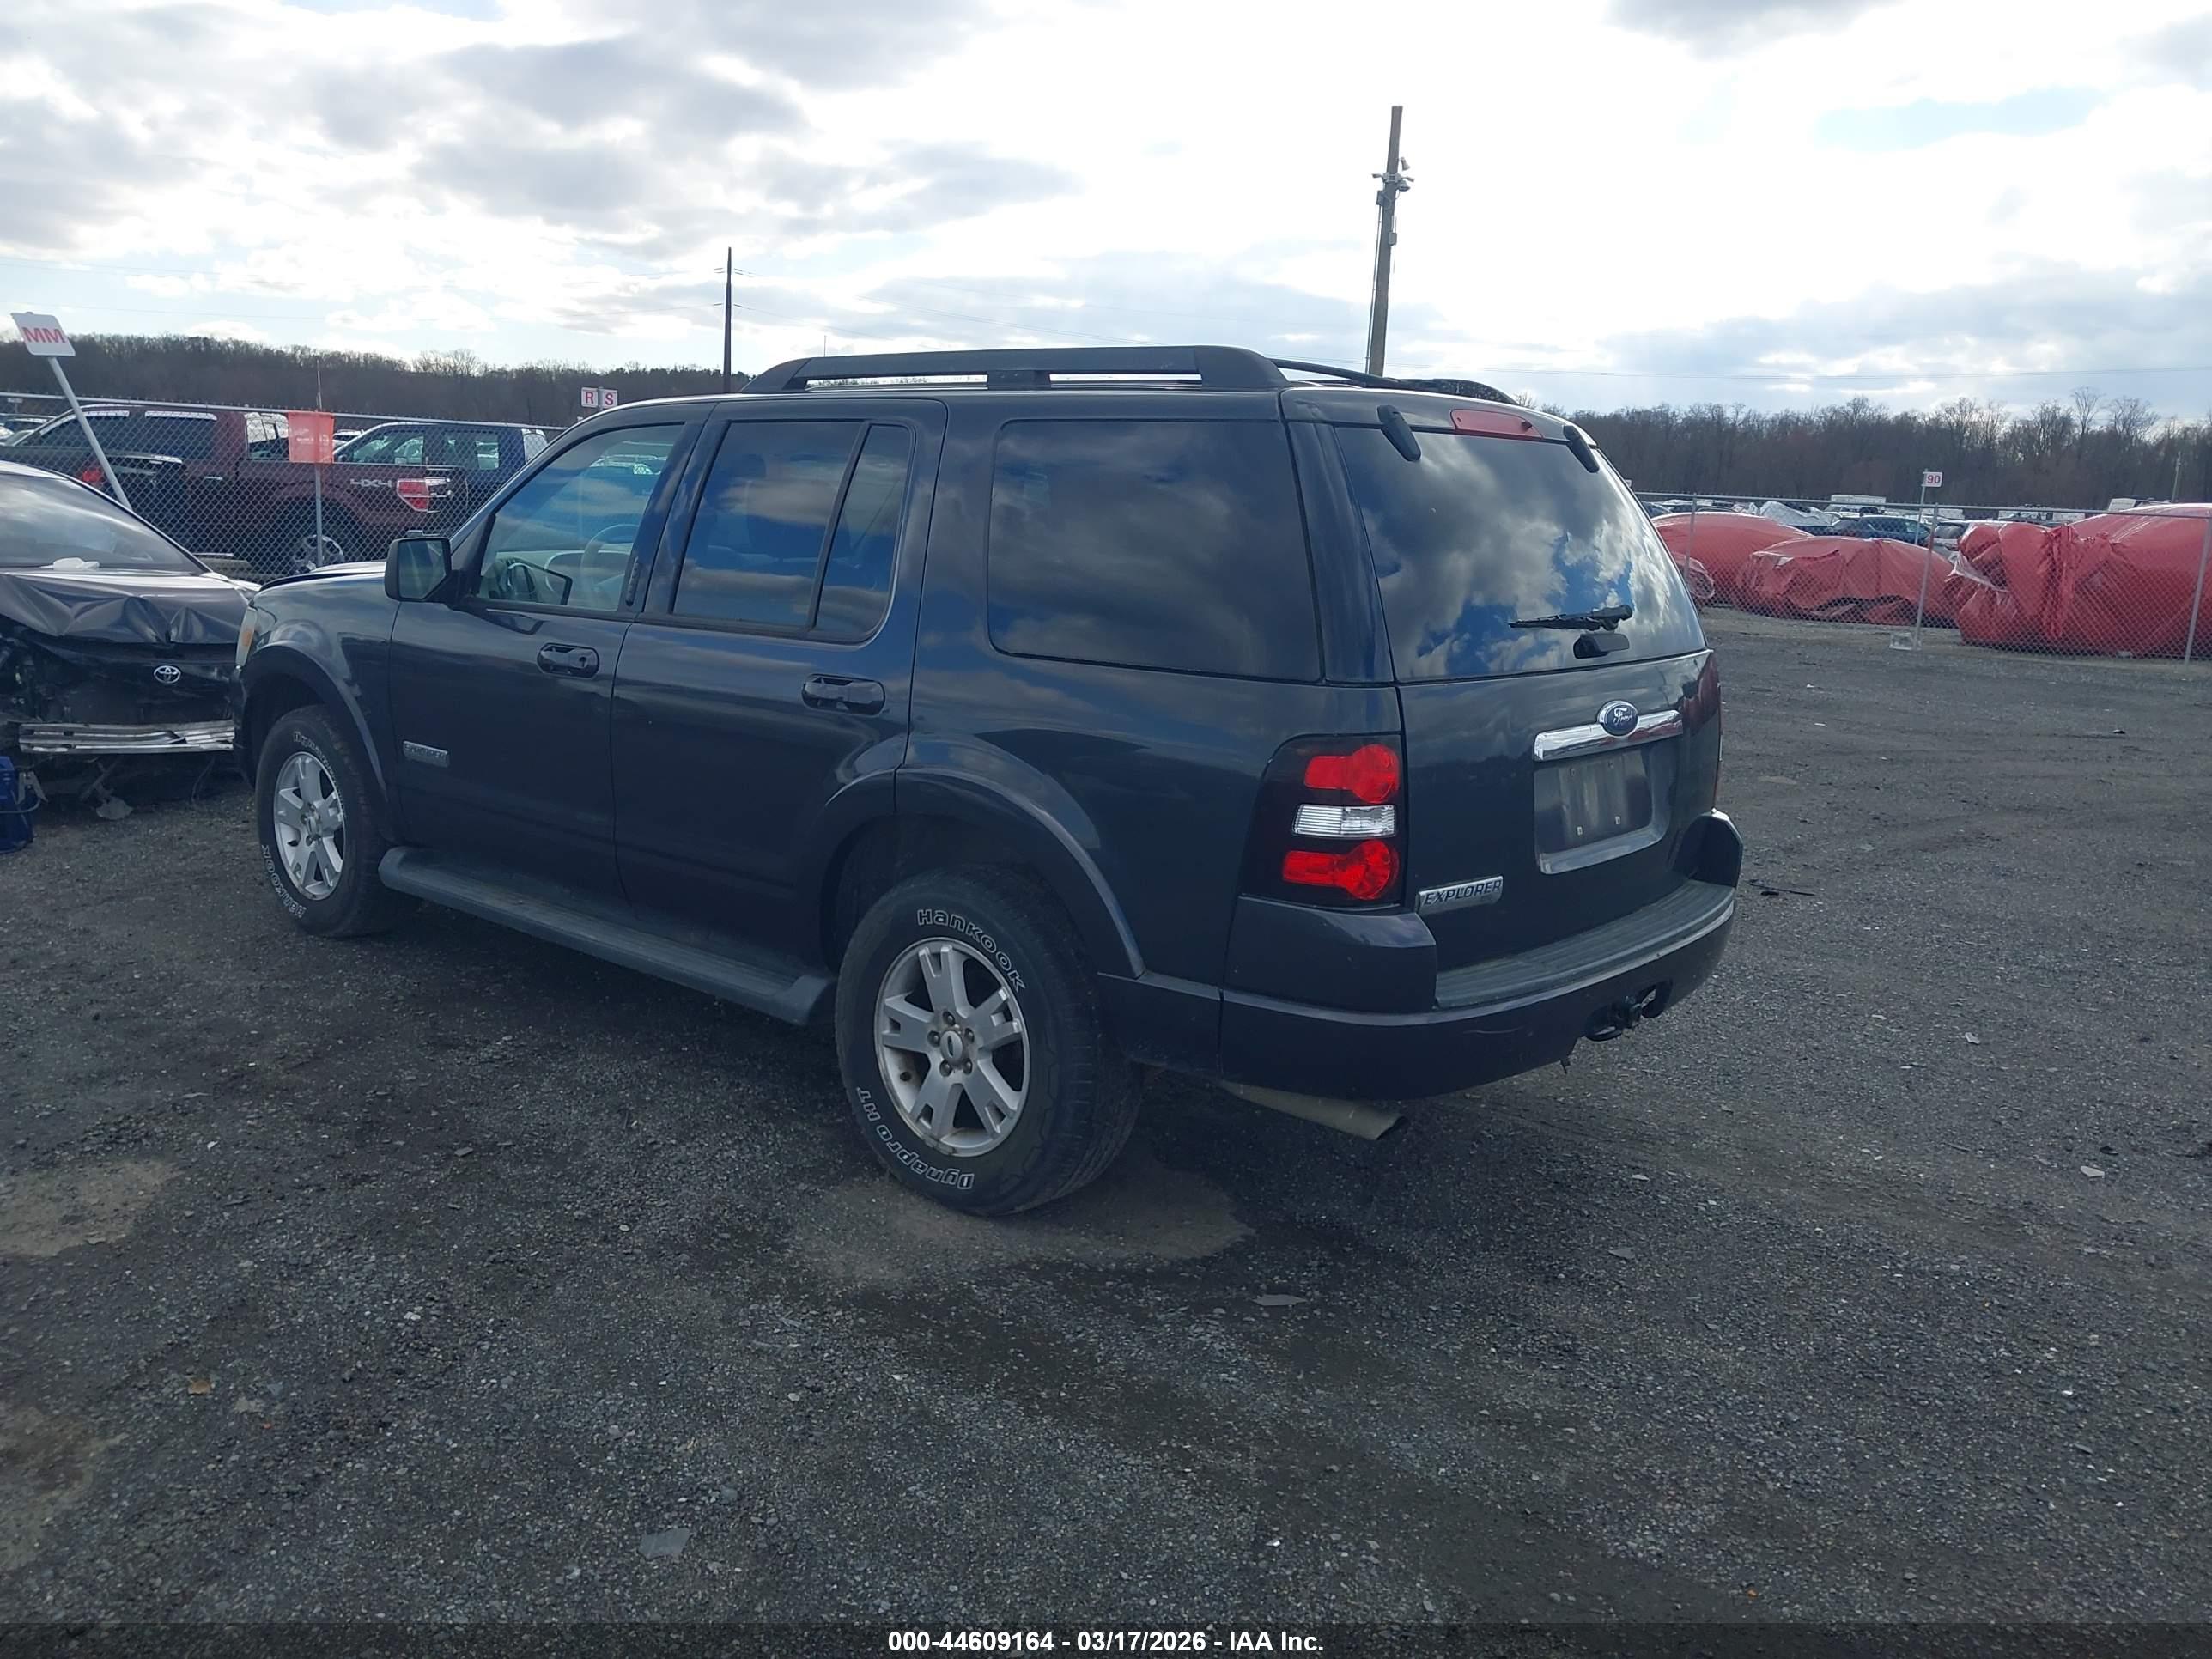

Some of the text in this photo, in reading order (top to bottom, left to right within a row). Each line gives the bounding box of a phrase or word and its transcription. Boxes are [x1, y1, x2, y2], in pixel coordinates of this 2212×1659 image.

[21, 327, 66, 343] MM
[586, 391, 594, 404] R
[605, 392, 614, 406] S
[1927, 474, 1941, 484] 90
[1613, 707, 1633, 726] Ford
[1423, 879, 1503, 906] EXPLORER
[856, 1086, 975, 1189] Dynapro HT
